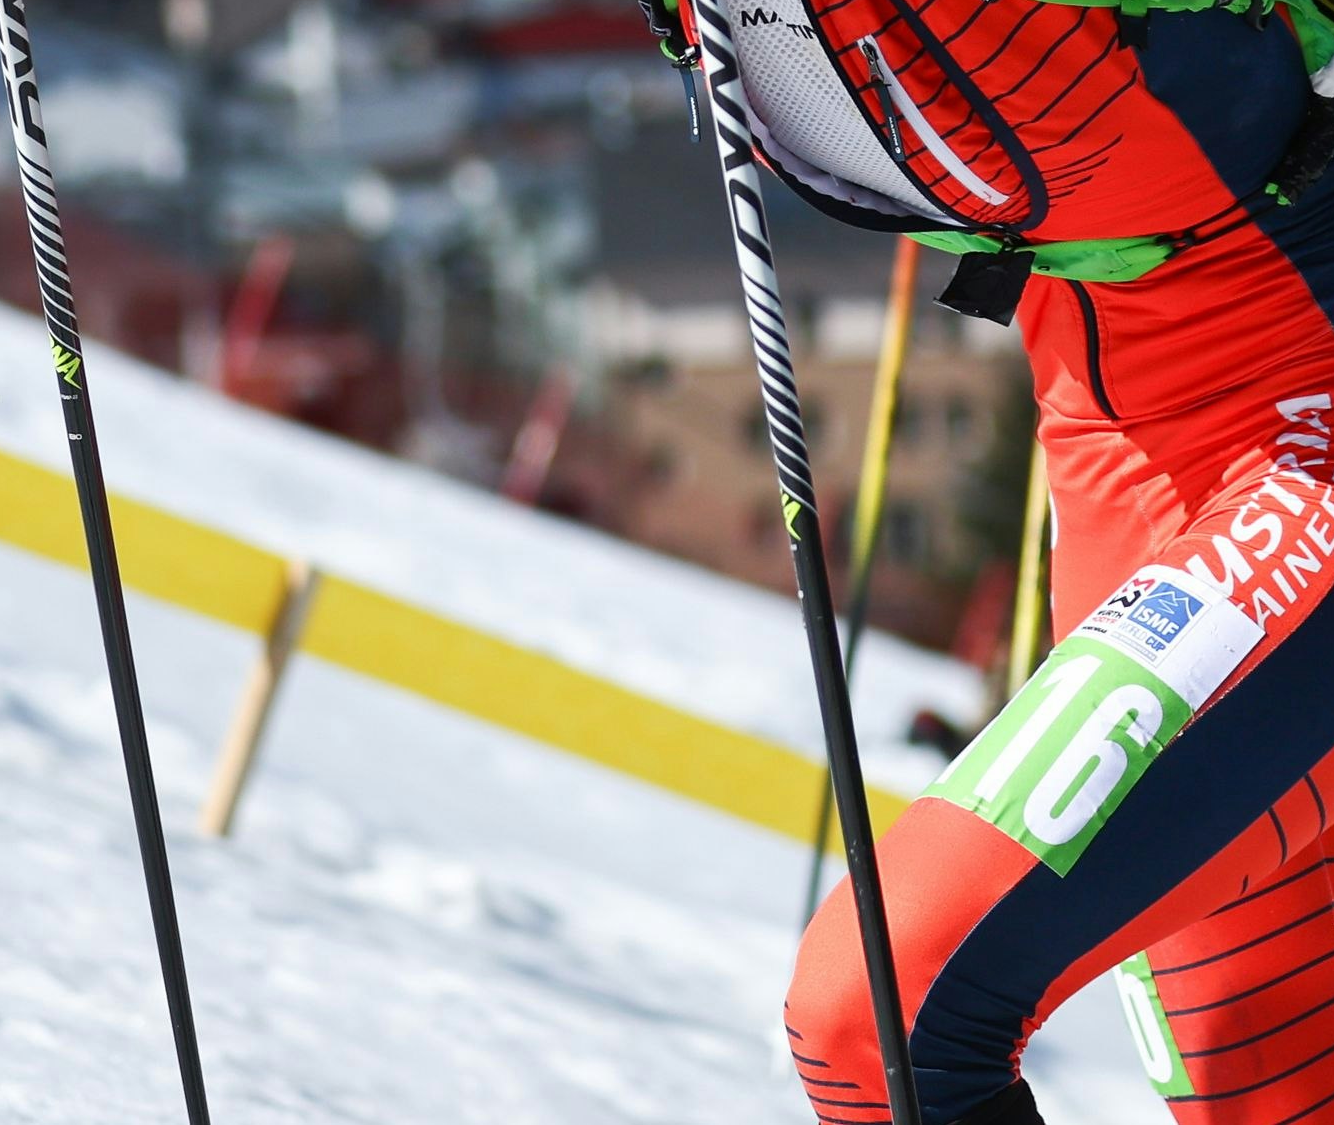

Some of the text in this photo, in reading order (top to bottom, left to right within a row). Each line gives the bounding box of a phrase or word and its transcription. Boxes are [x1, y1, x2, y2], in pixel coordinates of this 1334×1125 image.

[1185, 392, 1332, 597] USTRIA
[1133, 605, 1180, 637] ISMF
[1145, 635, 1167, 652] CUP
[937, 653, 1164, 846] 16
